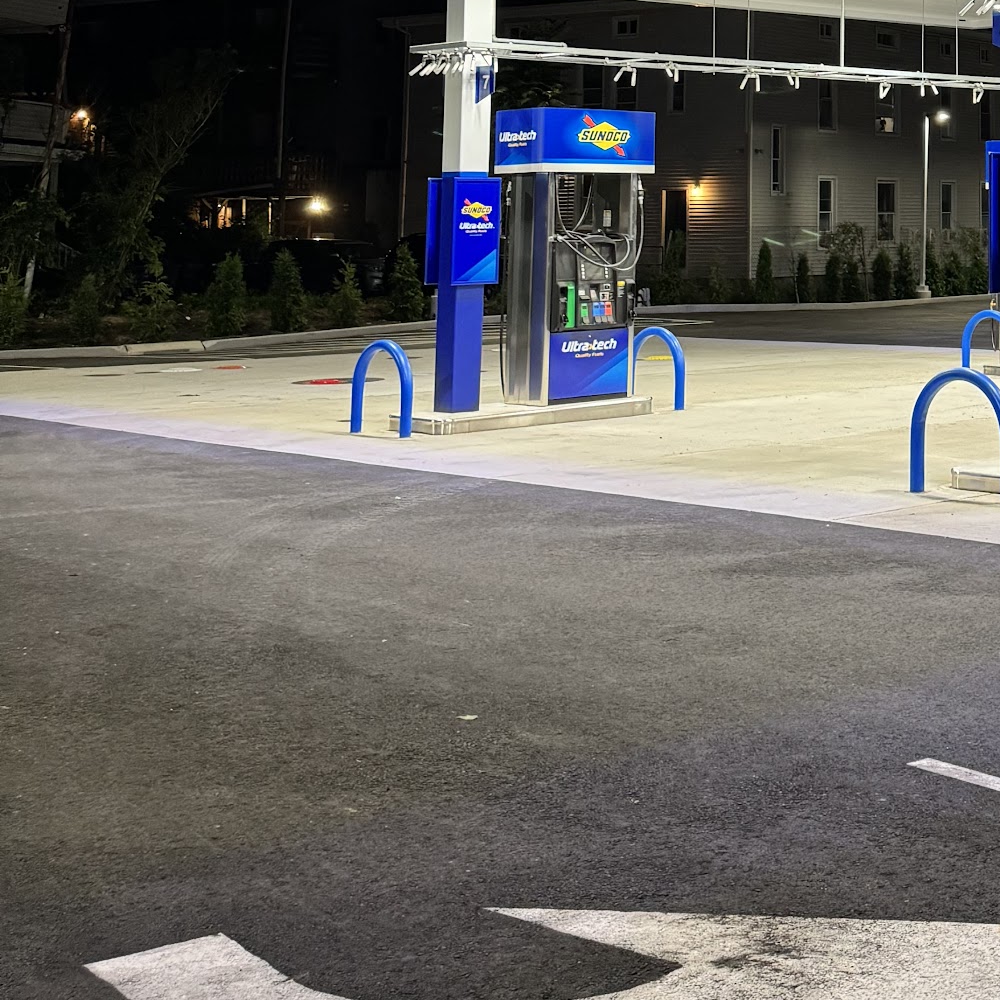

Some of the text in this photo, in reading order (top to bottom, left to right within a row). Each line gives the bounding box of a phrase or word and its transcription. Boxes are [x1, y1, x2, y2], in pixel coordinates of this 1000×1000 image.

[482, 74, 491, 90] 7
[581, 130, 629, 142] SUNOCO
[463, 206, 491, 214] SUNOCO
